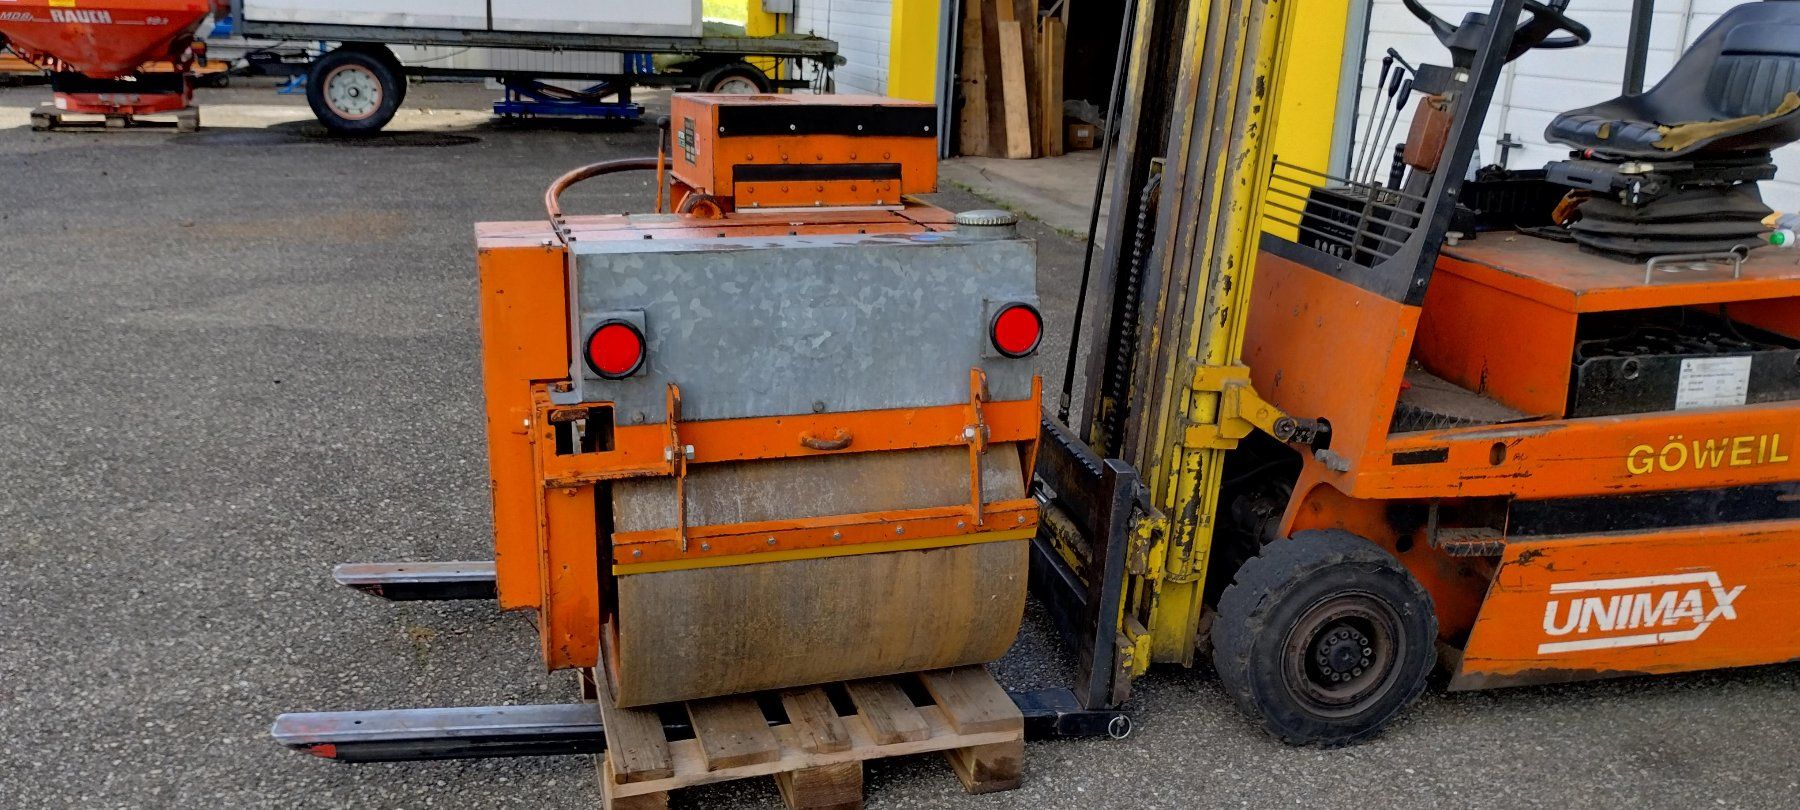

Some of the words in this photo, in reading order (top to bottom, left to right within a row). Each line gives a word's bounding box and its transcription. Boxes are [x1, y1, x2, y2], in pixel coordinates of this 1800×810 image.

[50, 9, 112, 24] RAUCH
[1626, 433, 1789, 475] GÖWEIL
[1543, 580, 1747, 637] UNIMAX
